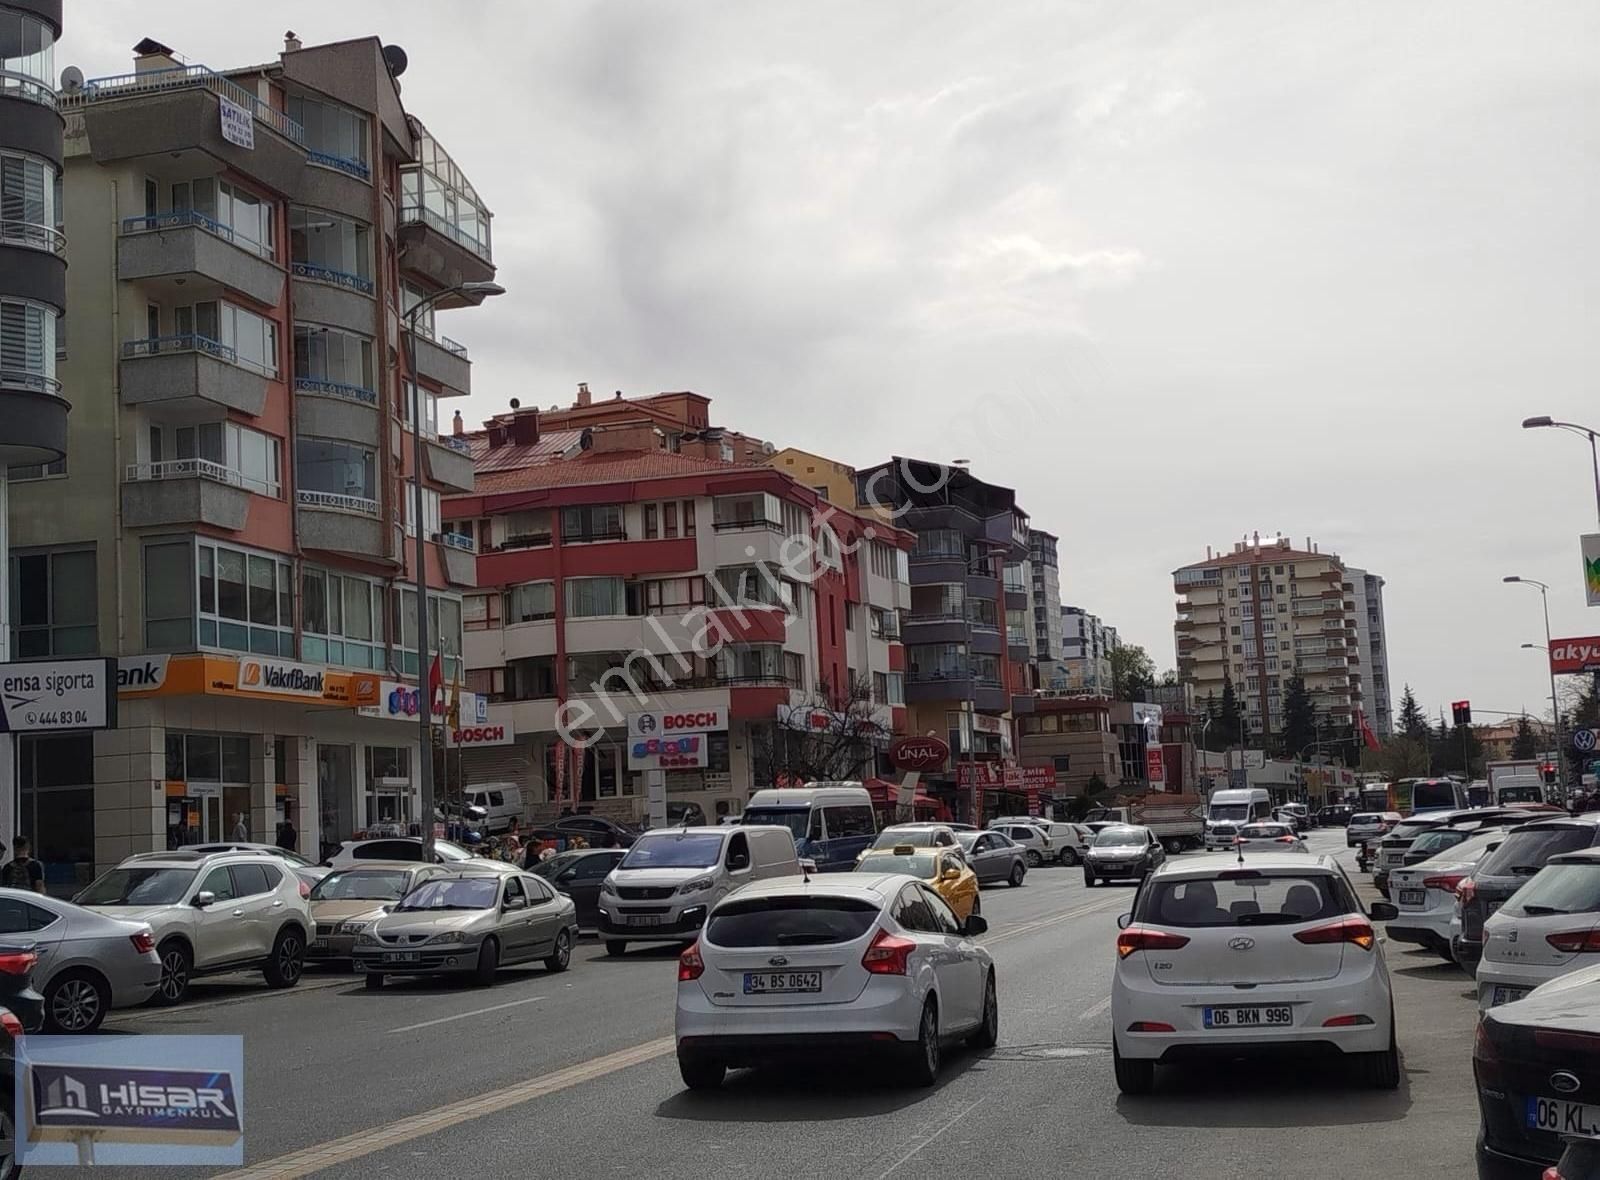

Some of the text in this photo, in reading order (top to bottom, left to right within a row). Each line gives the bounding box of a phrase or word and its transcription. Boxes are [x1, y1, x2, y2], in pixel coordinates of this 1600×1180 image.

[117, 662, 160, 686] ank
[46, 670, 94, 697] sigorta
[39, 710, 87, 724] 444 83 04
[663, 712, 717, 729] BOSCH
[453, 726, 504, 743] BOSCH
[752, 974, 817, 988] 34 BS 0642
[1214, 1008, 1290, 1024] 06 BKN 996
[1538, 1100, 1558, 1128] 06
